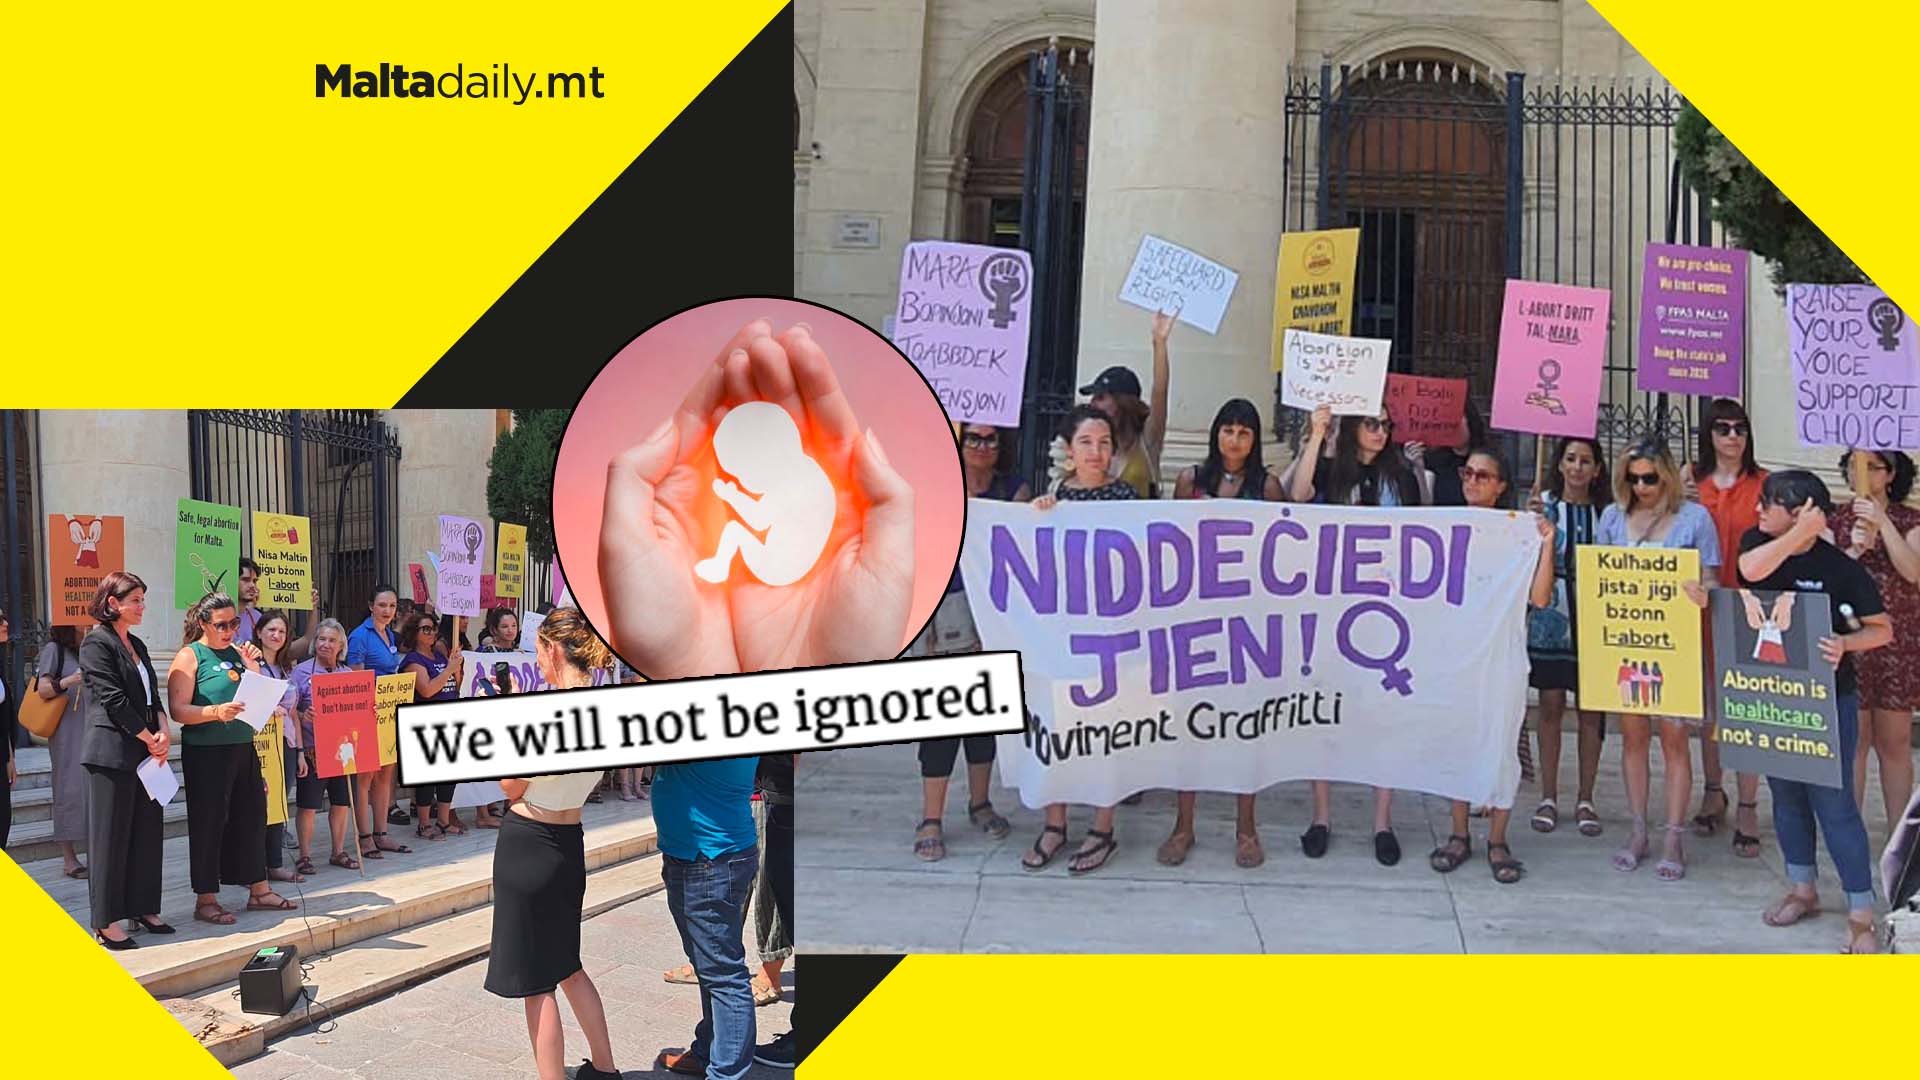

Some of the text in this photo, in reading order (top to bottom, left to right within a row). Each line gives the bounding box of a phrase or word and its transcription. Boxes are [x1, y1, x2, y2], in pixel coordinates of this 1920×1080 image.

[907, 247, 978, 291] MARA
[1564, 304, 1594, 321] DRITT
[1695, 308, 1730, 322] MALTA
[1792, 286, 1864, 315] RAISE
[1289, 331, 1373, 360] Abortion
[1793, 315, 1870, 350] YOUR
[1794, 347, 1871, 376] VOICE
[1798, 379, 1919, 411] SUPPORT
[1803, 411, 1919, 449] CHOICE
[197, 513, 213, 528] legal
[213, 516, 240, 531] abortion
[194, 532, 204, 545] for
[258, 549, 308, 563] Nisa Maltin
[278, 565, 305, 576] bżonn
[989, 508, 1472, 618] NIDDEĊIEDI
[64, 576, 99, 588] ABORTION
[65, 605, 86, 617] NOT A
[273, 593, 297, 604] ukoll.
[1606, 601, 1665, 621] bżonn
[1070, 613, 1318, 708] JIEN!
[397, 679, 415, 694] legal
[1722, 668, 1828, 700] Abortion is
[1024, 691, 1343, 766] Moviment Graffitti
[1722, 727, 1836, 759] not a crime.
